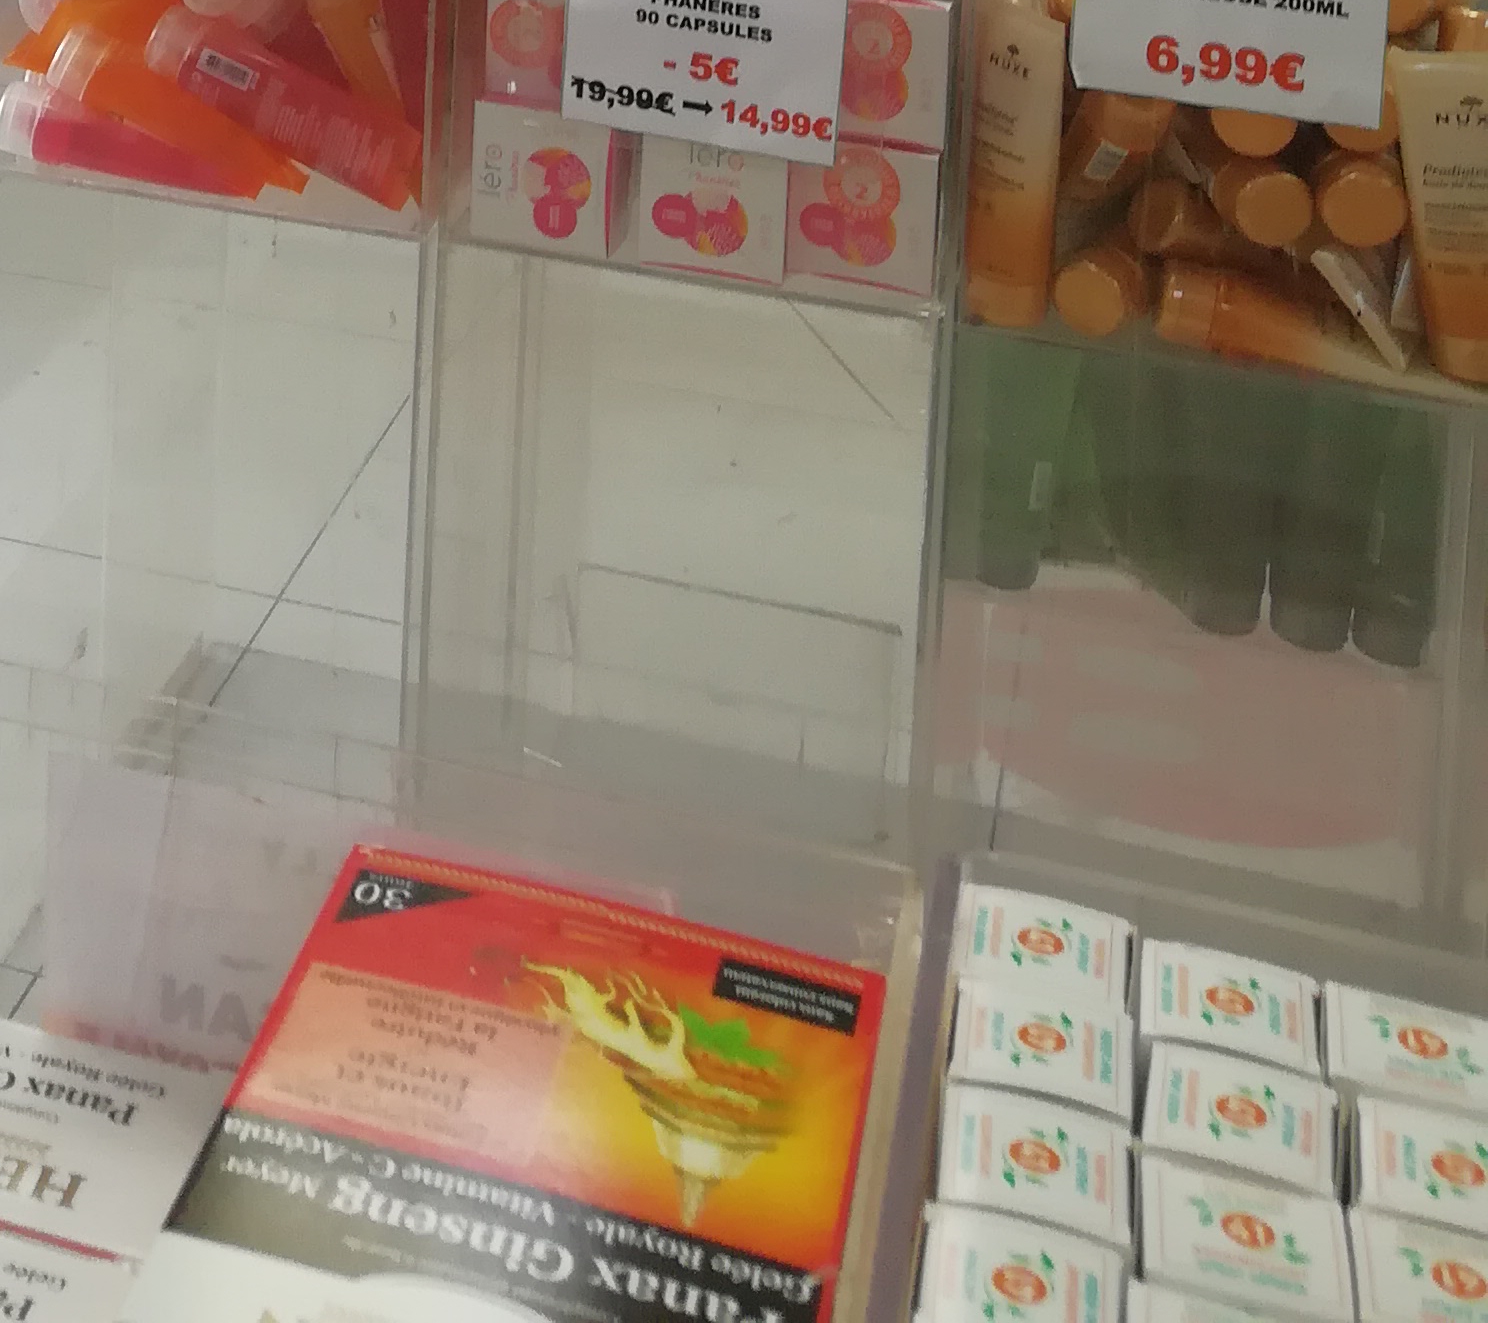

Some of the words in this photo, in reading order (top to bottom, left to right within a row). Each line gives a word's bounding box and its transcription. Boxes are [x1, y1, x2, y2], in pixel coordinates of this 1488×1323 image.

[636, 8, 660, 25] 90
[666, 14, 773, 42] CAPSULES
[689, 52, 739, 86] 5€
[1146, 35, 1305, 92] 6,99€
[571, 76, 676, 116] 19,99€
[721, 99, 833, 141] 14,99€
[352, 879, 413, 911] 30
[23, 1076, 140, 1126] Panax
[402, 1162, 556, 1226] Vitamine
[329, 1175, 575, 1283] Ginseng
